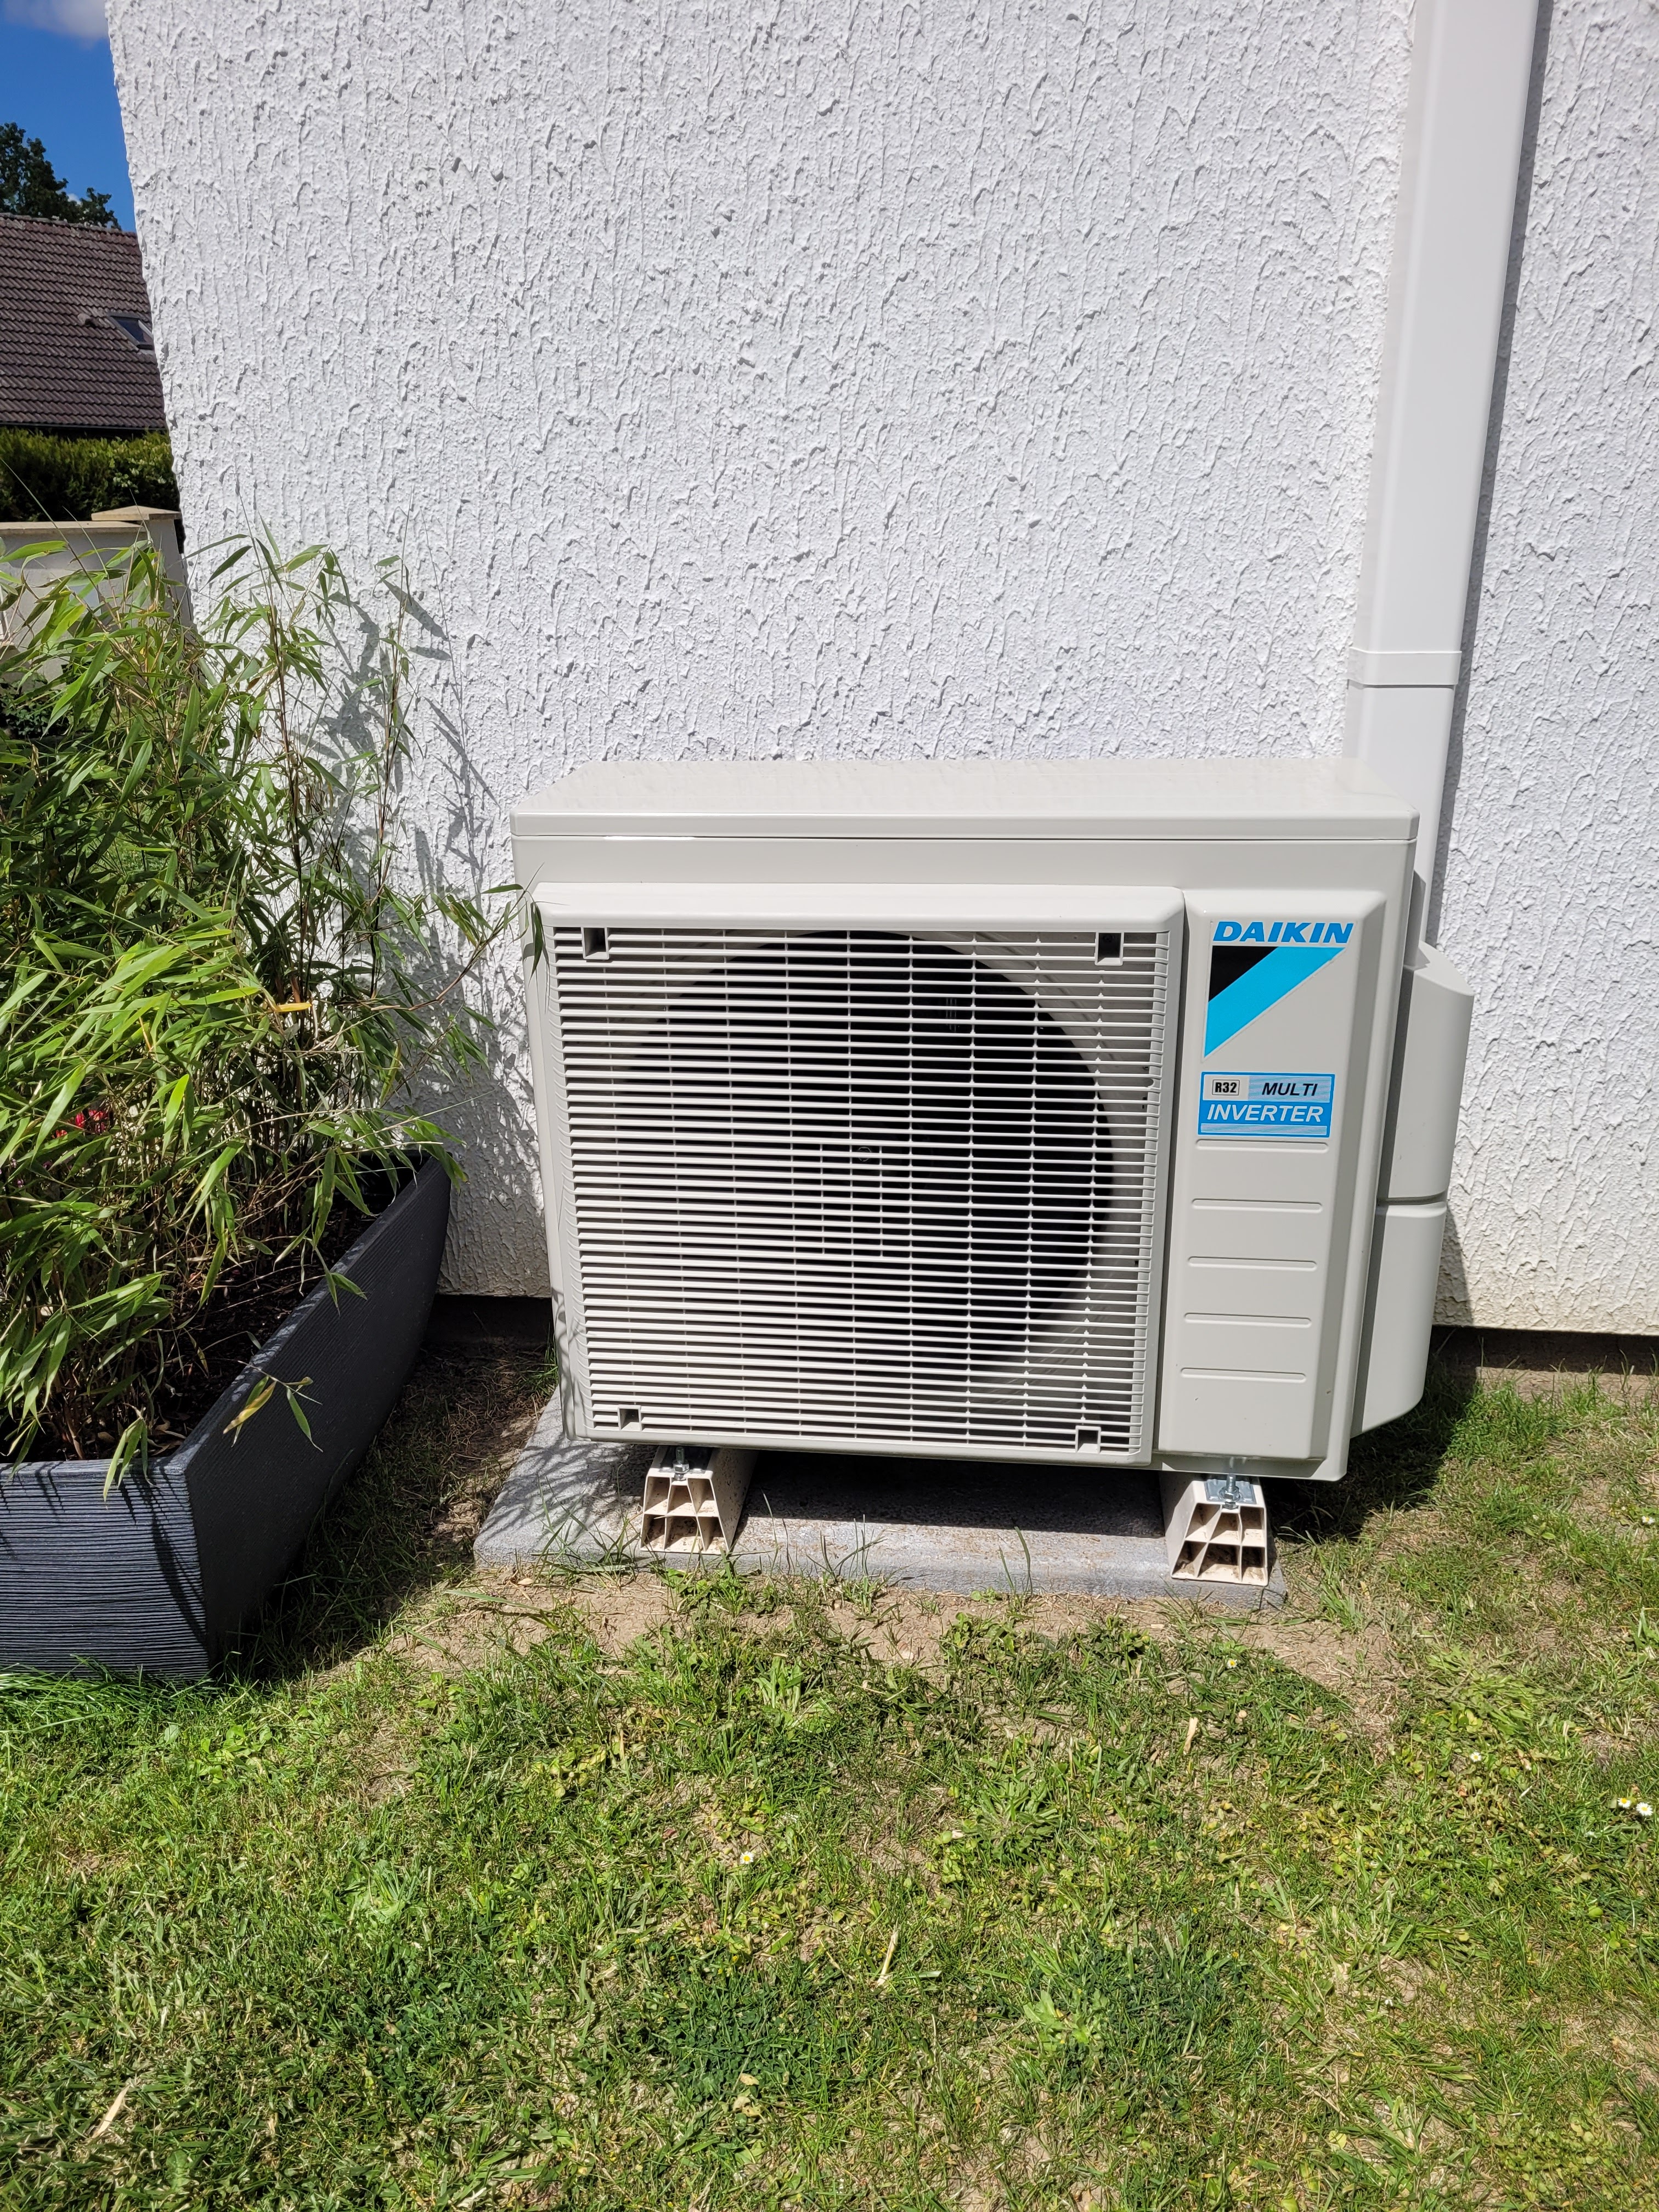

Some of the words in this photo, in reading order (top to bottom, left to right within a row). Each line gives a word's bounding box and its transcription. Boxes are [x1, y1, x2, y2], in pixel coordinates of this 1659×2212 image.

[1212, 921, 1354, 944] DAIKIN
[1215, 1082, 1237, 1093] R32
[1262, 1082, 1318, 1097] MULTI
[1207, 1104, 1323, 1122] INVERTER
